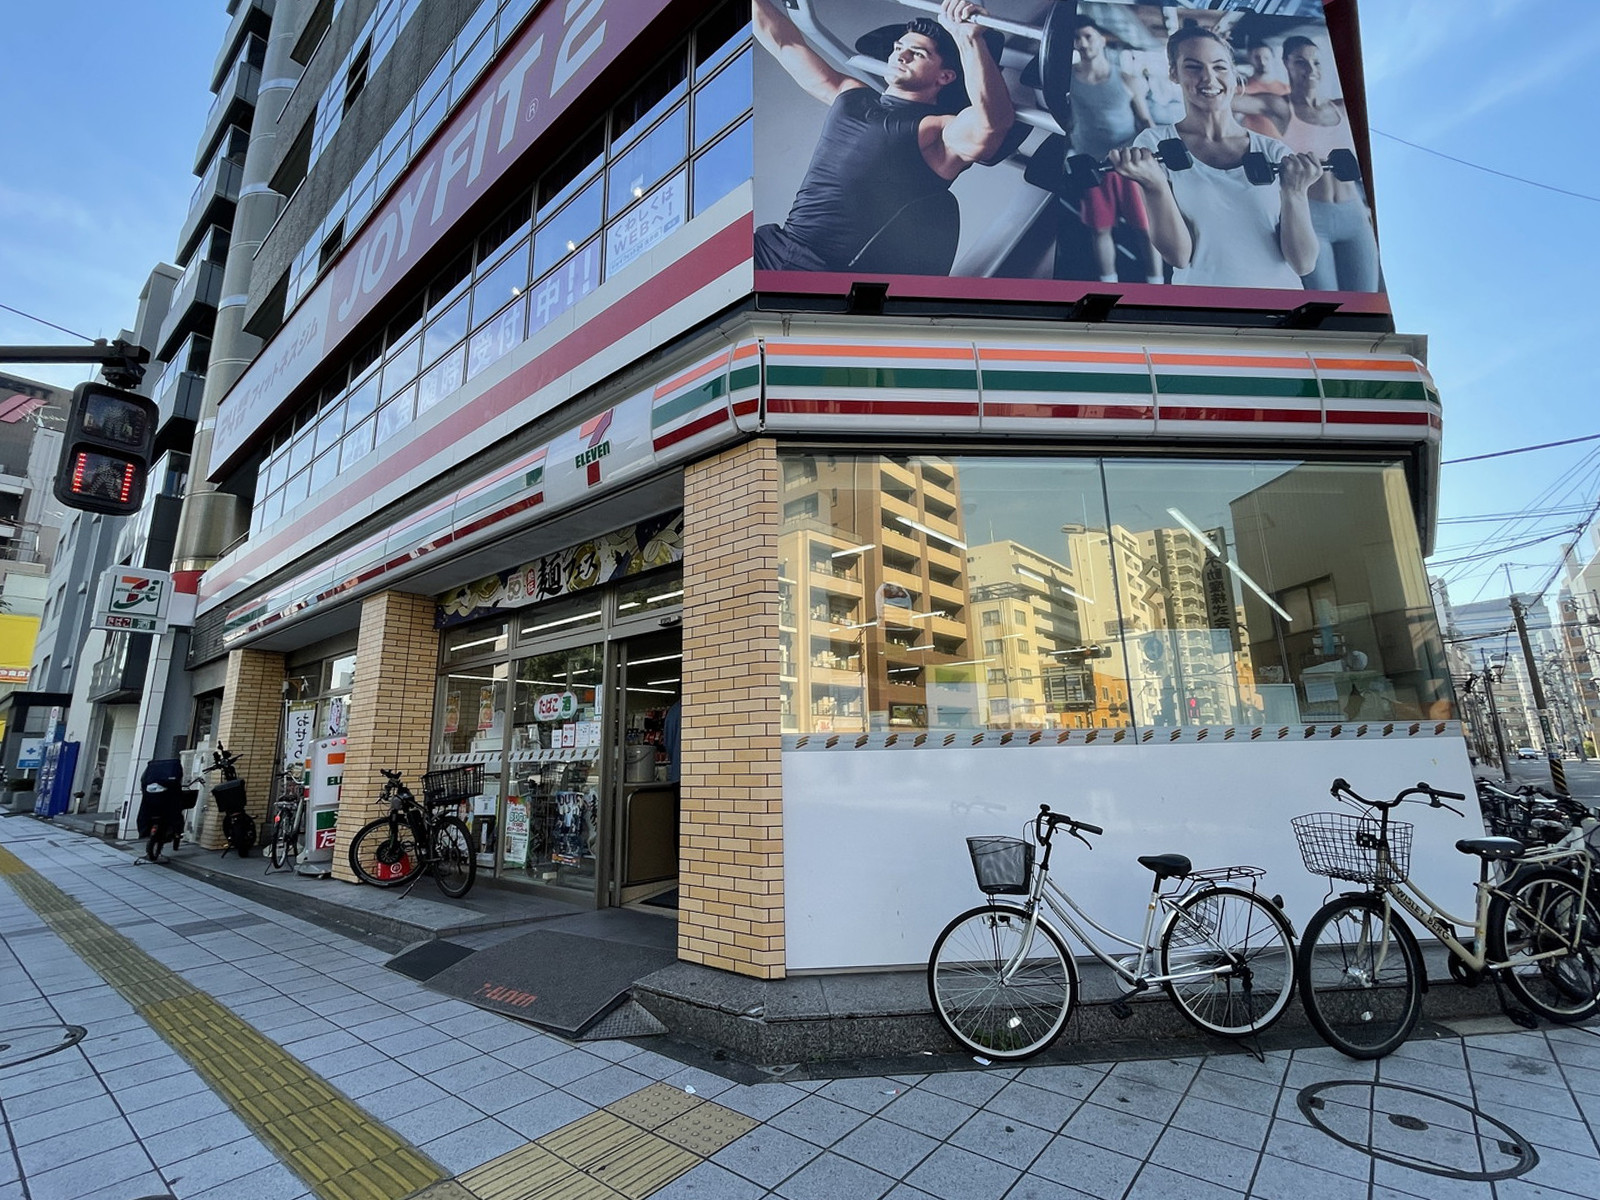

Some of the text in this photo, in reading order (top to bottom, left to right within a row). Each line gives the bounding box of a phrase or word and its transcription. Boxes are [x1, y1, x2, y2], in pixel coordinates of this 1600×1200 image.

[338, 34, 544, 323] JOYFIT
[614, 186, 674, 238] くわしくは
[536, 549, 599, 601] 麺フェス
[106, 616, 131, 628] たばこ
[538, 697, 559, 714] たばこ
[1396, 887, 1451, 940] WISLEY BERG
